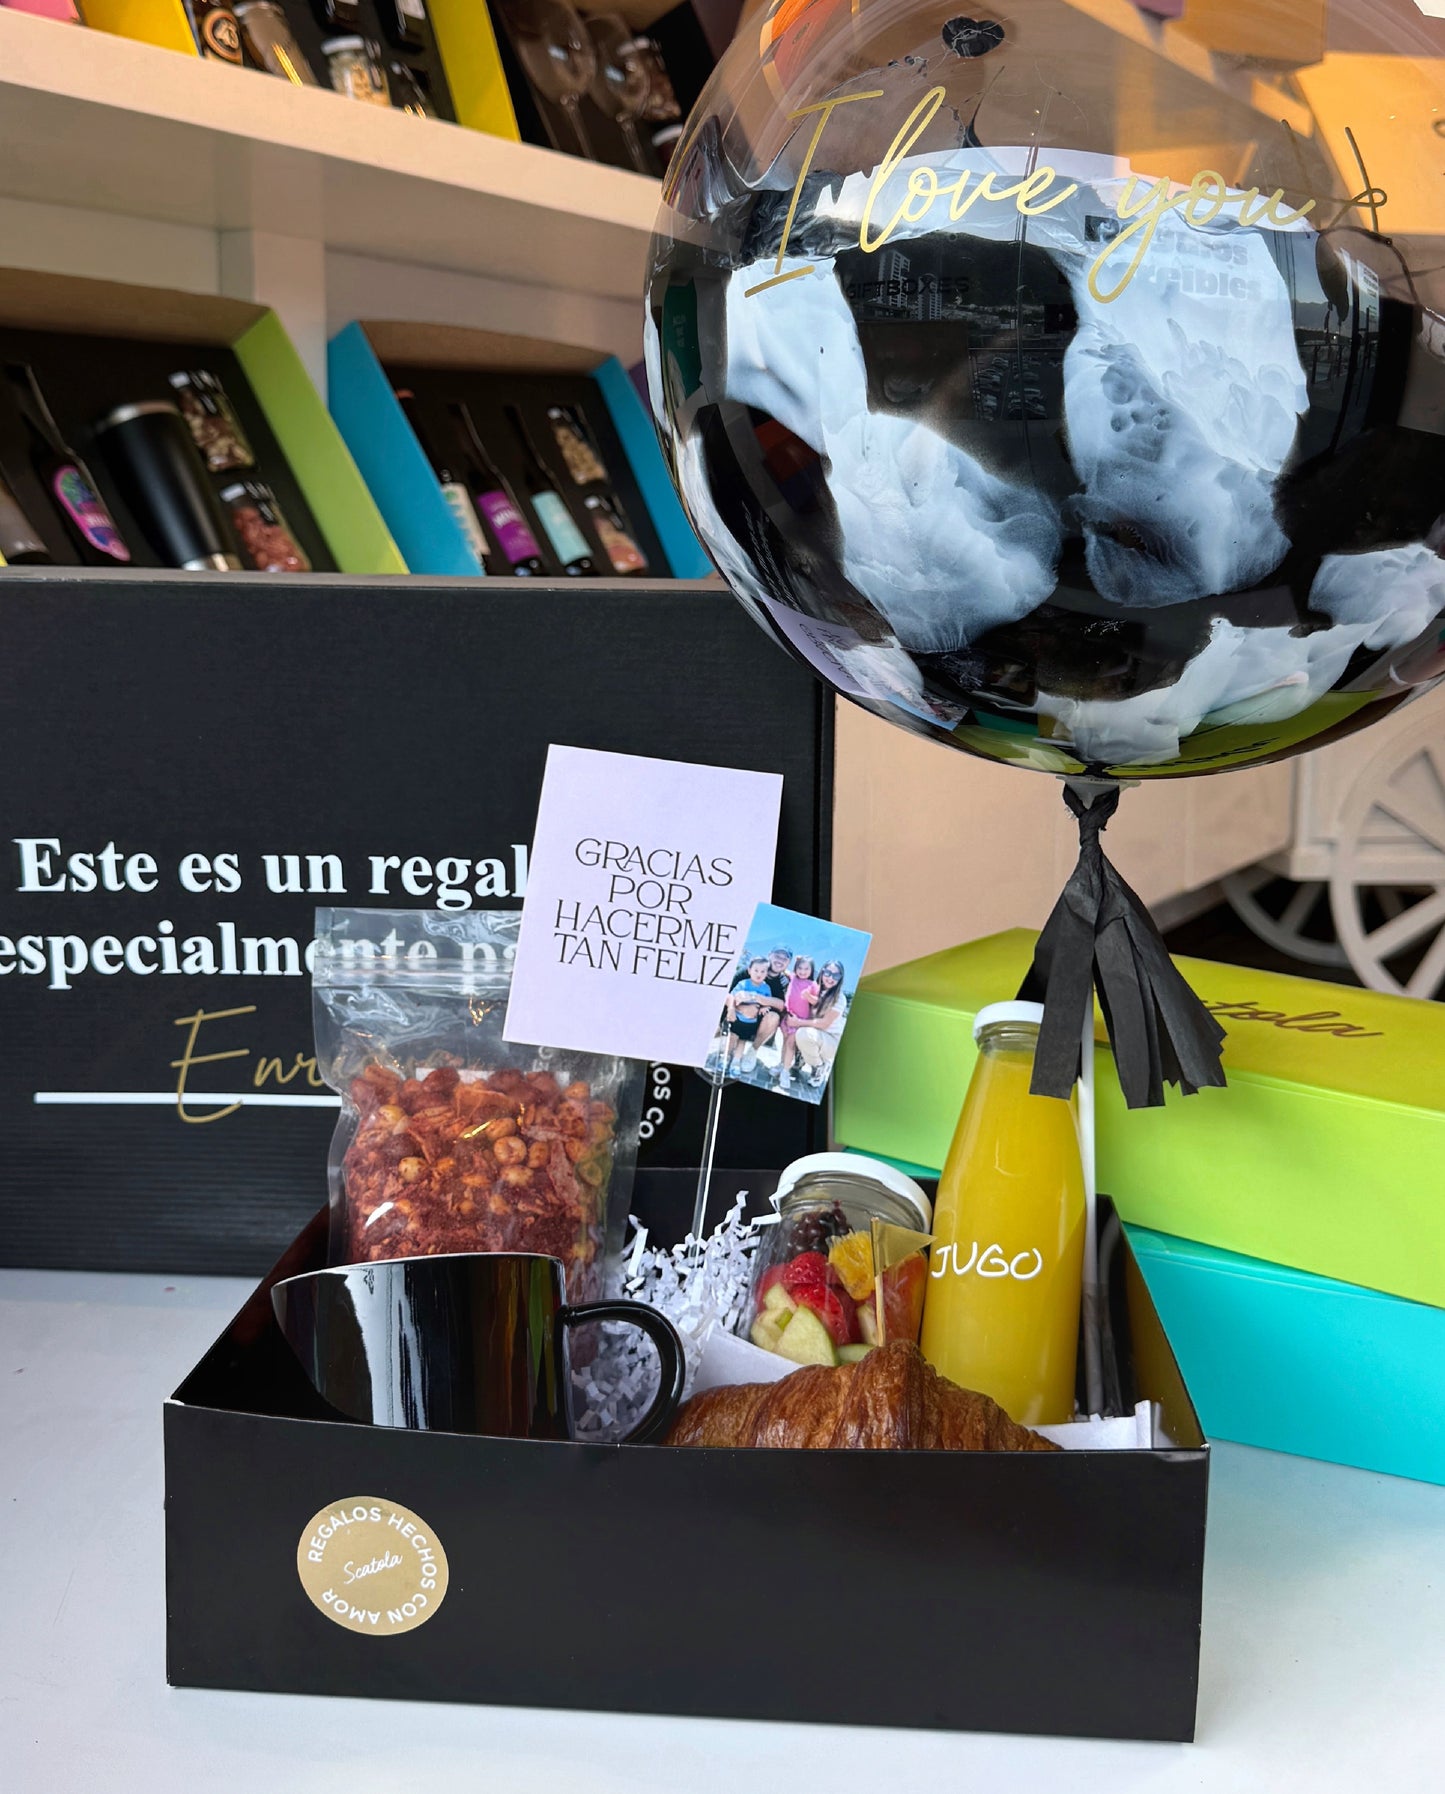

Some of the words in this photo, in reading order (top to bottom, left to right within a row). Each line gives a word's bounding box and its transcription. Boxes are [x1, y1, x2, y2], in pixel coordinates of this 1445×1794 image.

[744, 90, 884, 298] I
[859, 86, 1078, 253] love
[1088, 170, 1316, 304] you
[846, 276, 970, 299] GIFTBOXES
[11, 838, 159, 893] Este
[178, 852, 243, 893] es
[261, 853, 348, 893] un
[368, 844, 528, 911] regal
[575, 837, 733, 886] GRACIAS
[607, 874, 693, 914] POR
[554, 898, 738, 955] HACERME
[554, 932, 622, 971] TAN
[631, 945, 732, 988] FELIZ
[1200, 999, 1384, 1038] tola
[931, 1241, 1042, 1280] JUGO
[308, 1506, 382, 1562] REGALOS
[388, 1513, 438, 1590] HECHOS
[343, 1550, 403, 1585] Scatola
[321, 1588, 381, 1625] AMOR
[386, 1593, 428, 1624] CON
